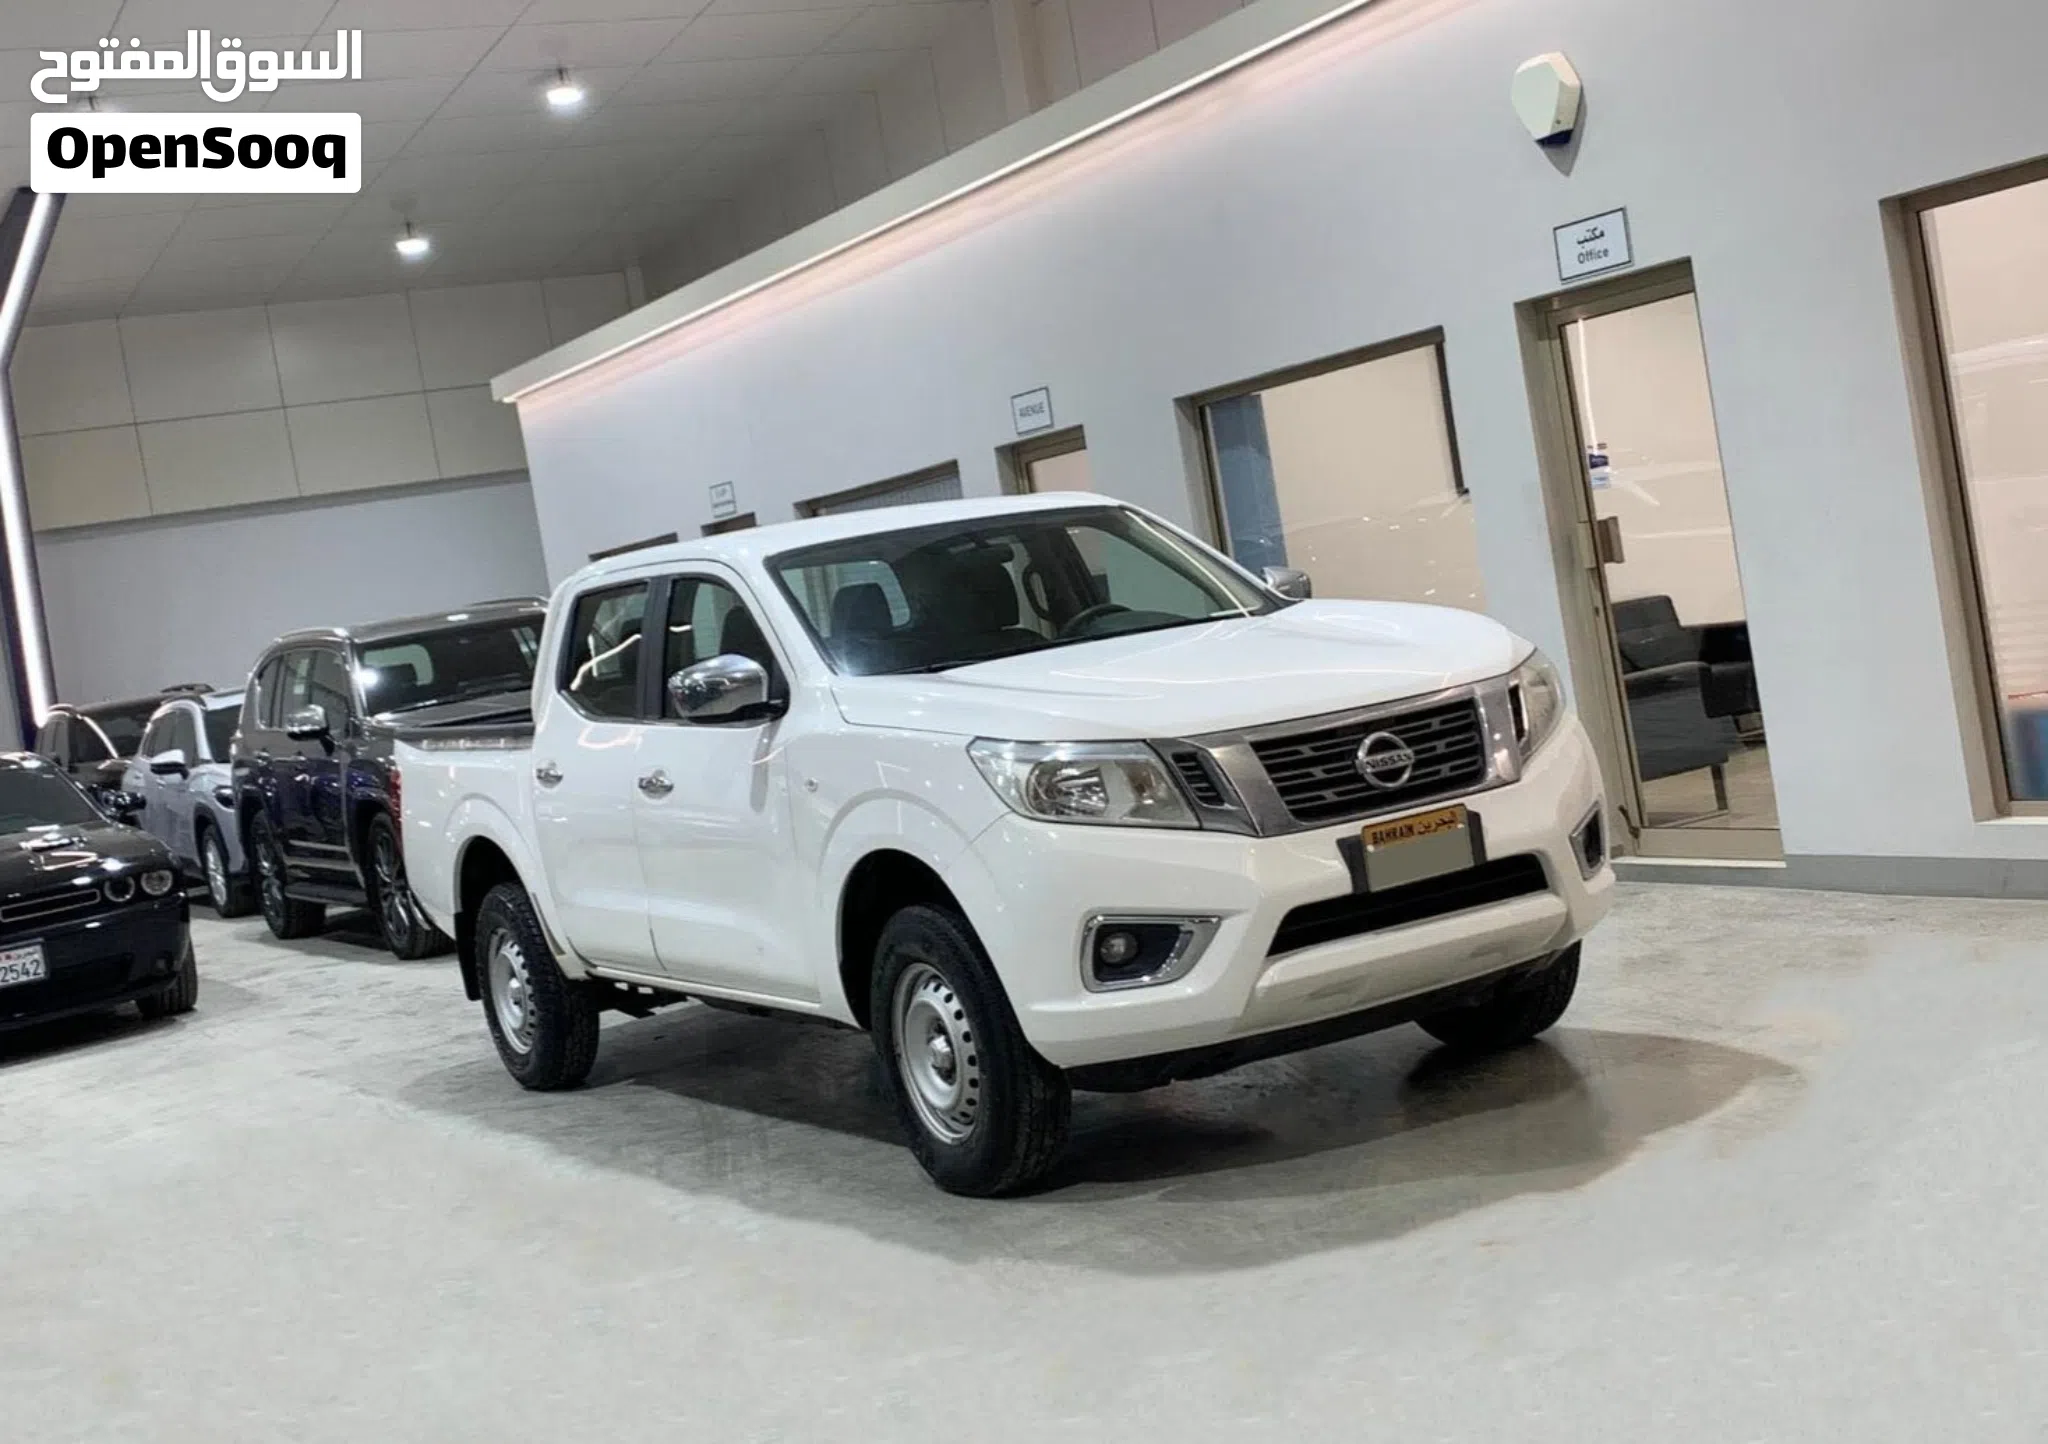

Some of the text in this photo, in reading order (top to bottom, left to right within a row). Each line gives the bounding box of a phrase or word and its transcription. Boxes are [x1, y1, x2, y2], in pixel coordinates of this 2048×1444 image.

[1576, 226, 1605, 249] مكتب
[1577, 248, 1610, 265] Office
[1365, 753, 1411, 769] NISSAN
[1371, 823, 1415, 845] BAHRAIN
[0, 959, 42, 983] 2542
